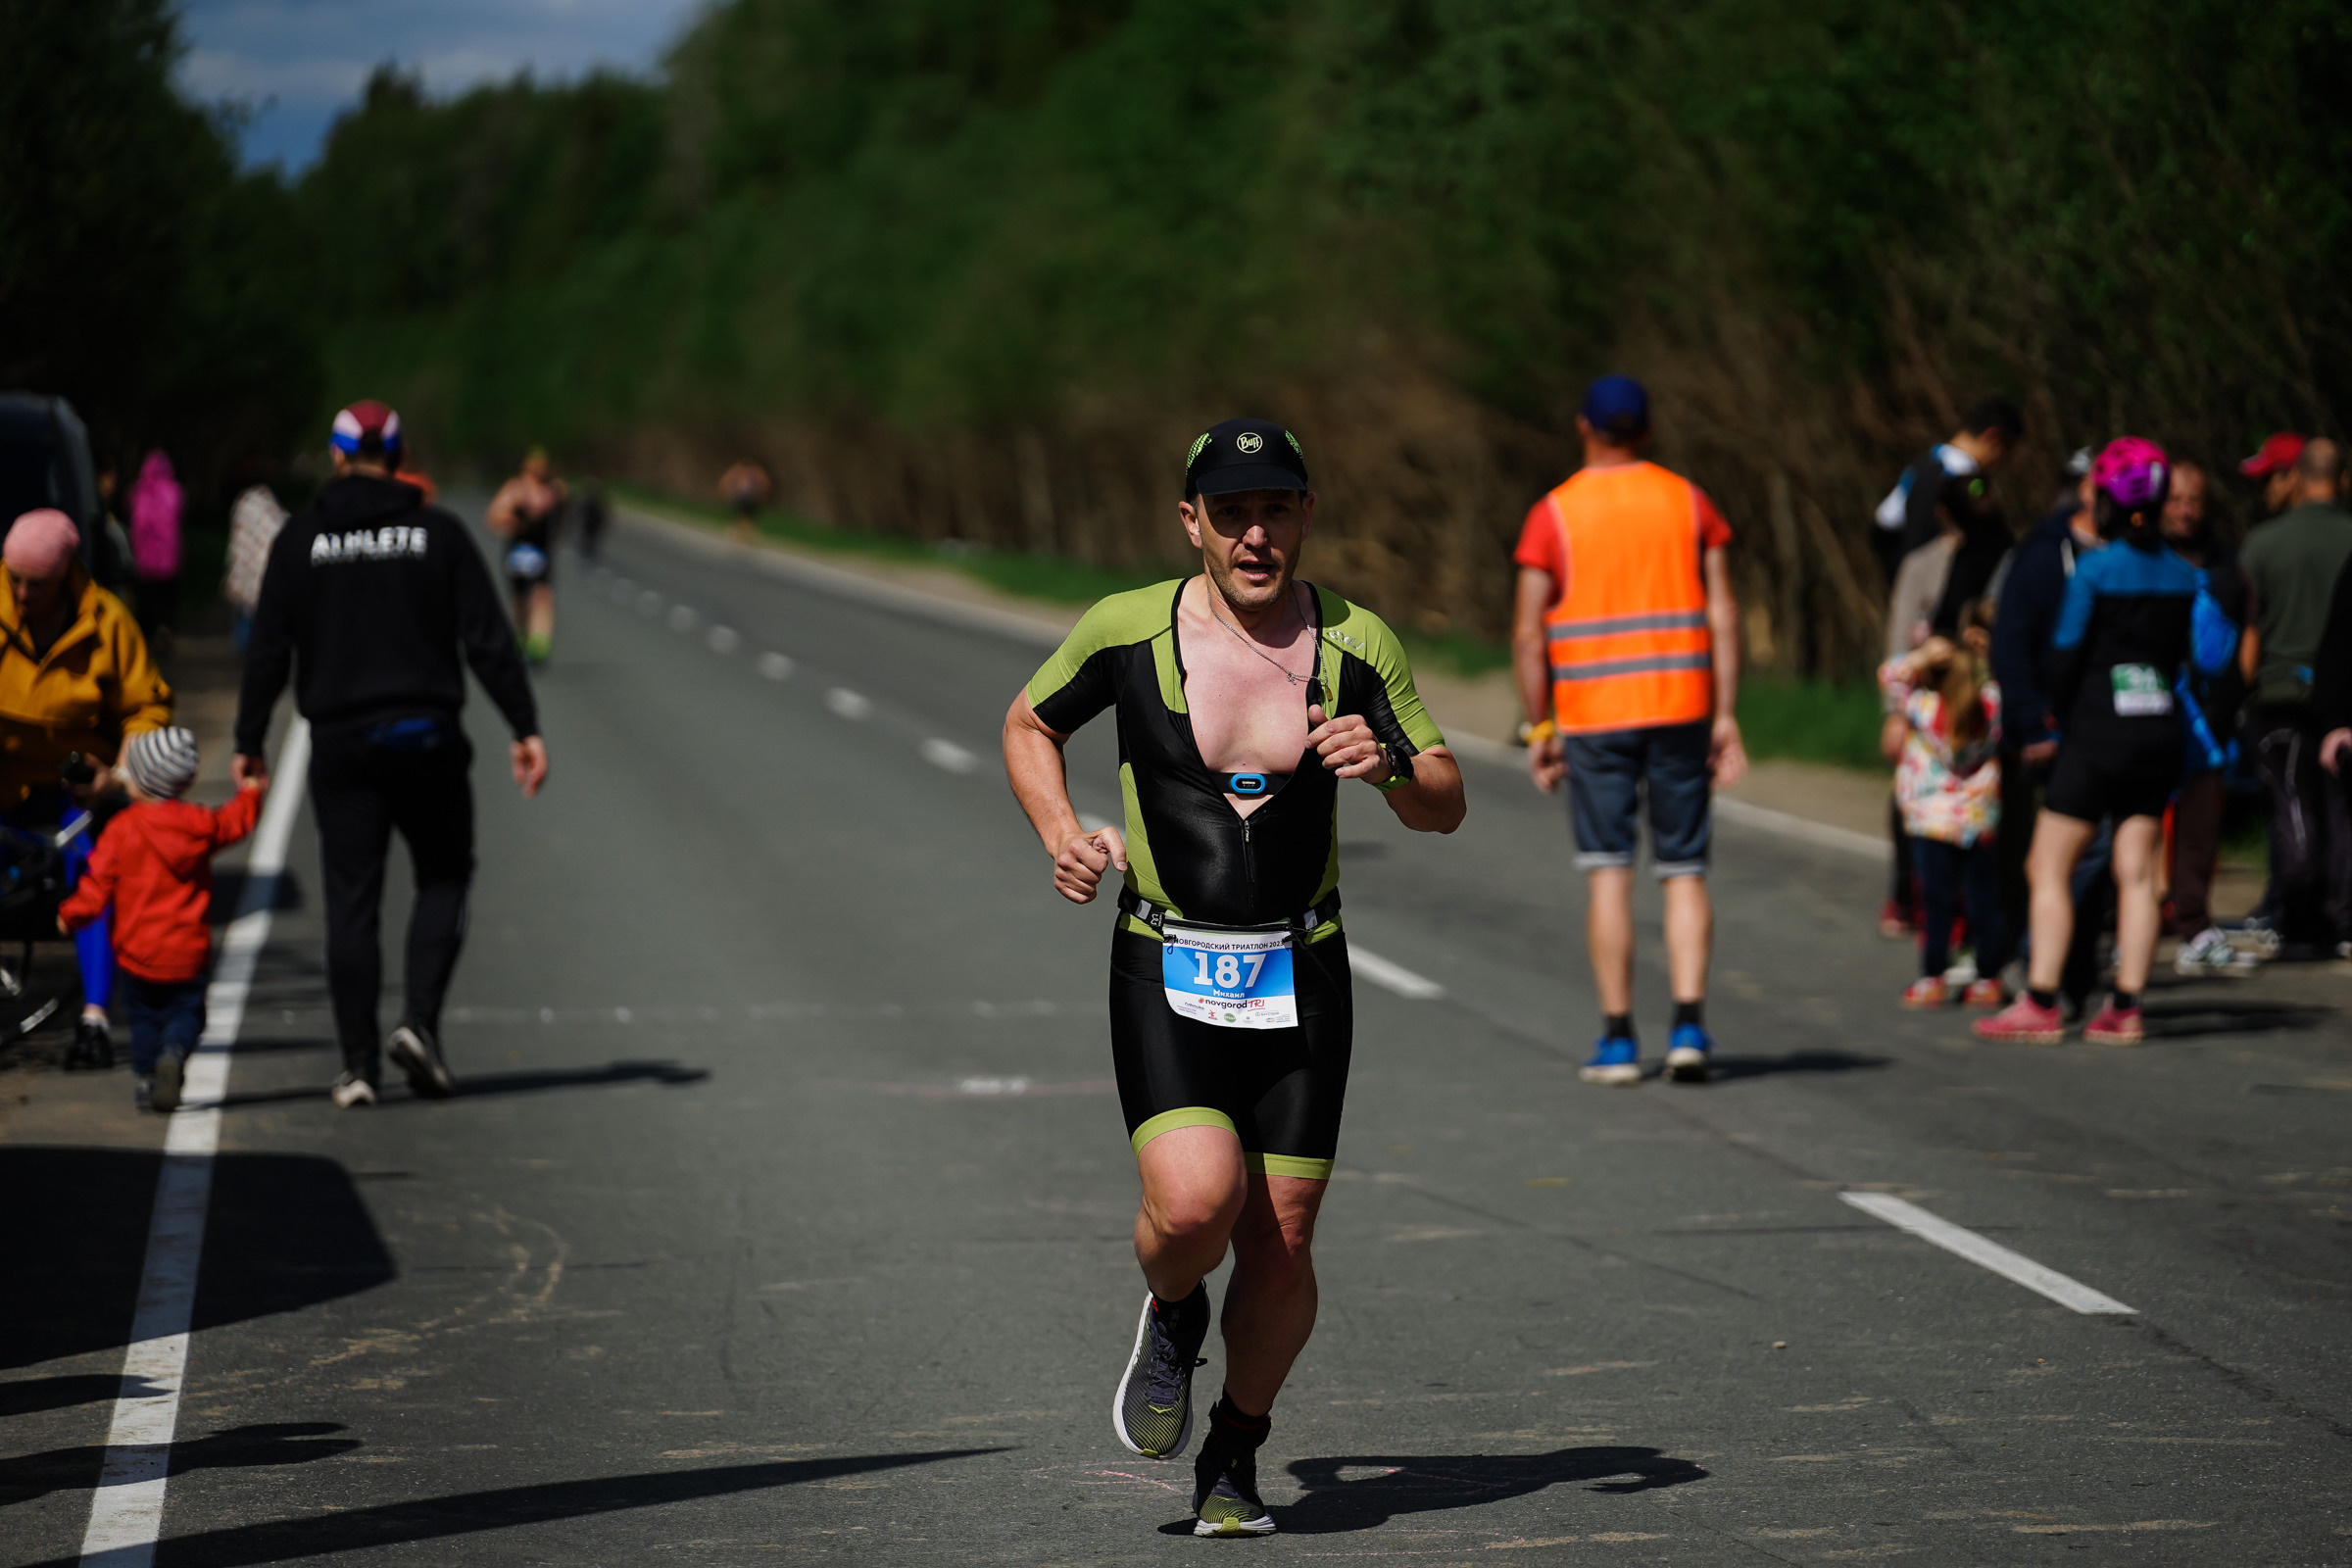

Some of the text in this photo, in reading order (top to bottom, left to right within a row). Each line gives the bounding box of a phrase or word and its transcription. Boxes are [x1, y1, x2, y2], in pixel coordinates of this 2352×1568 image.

[1240, 435, 1260, 450] Buff
[1232, 941, 1268, 951] ТРИАТЛОН
[1194, 952, 1266, 988] 187
[1213, 989, 1245, 998] Михаил
